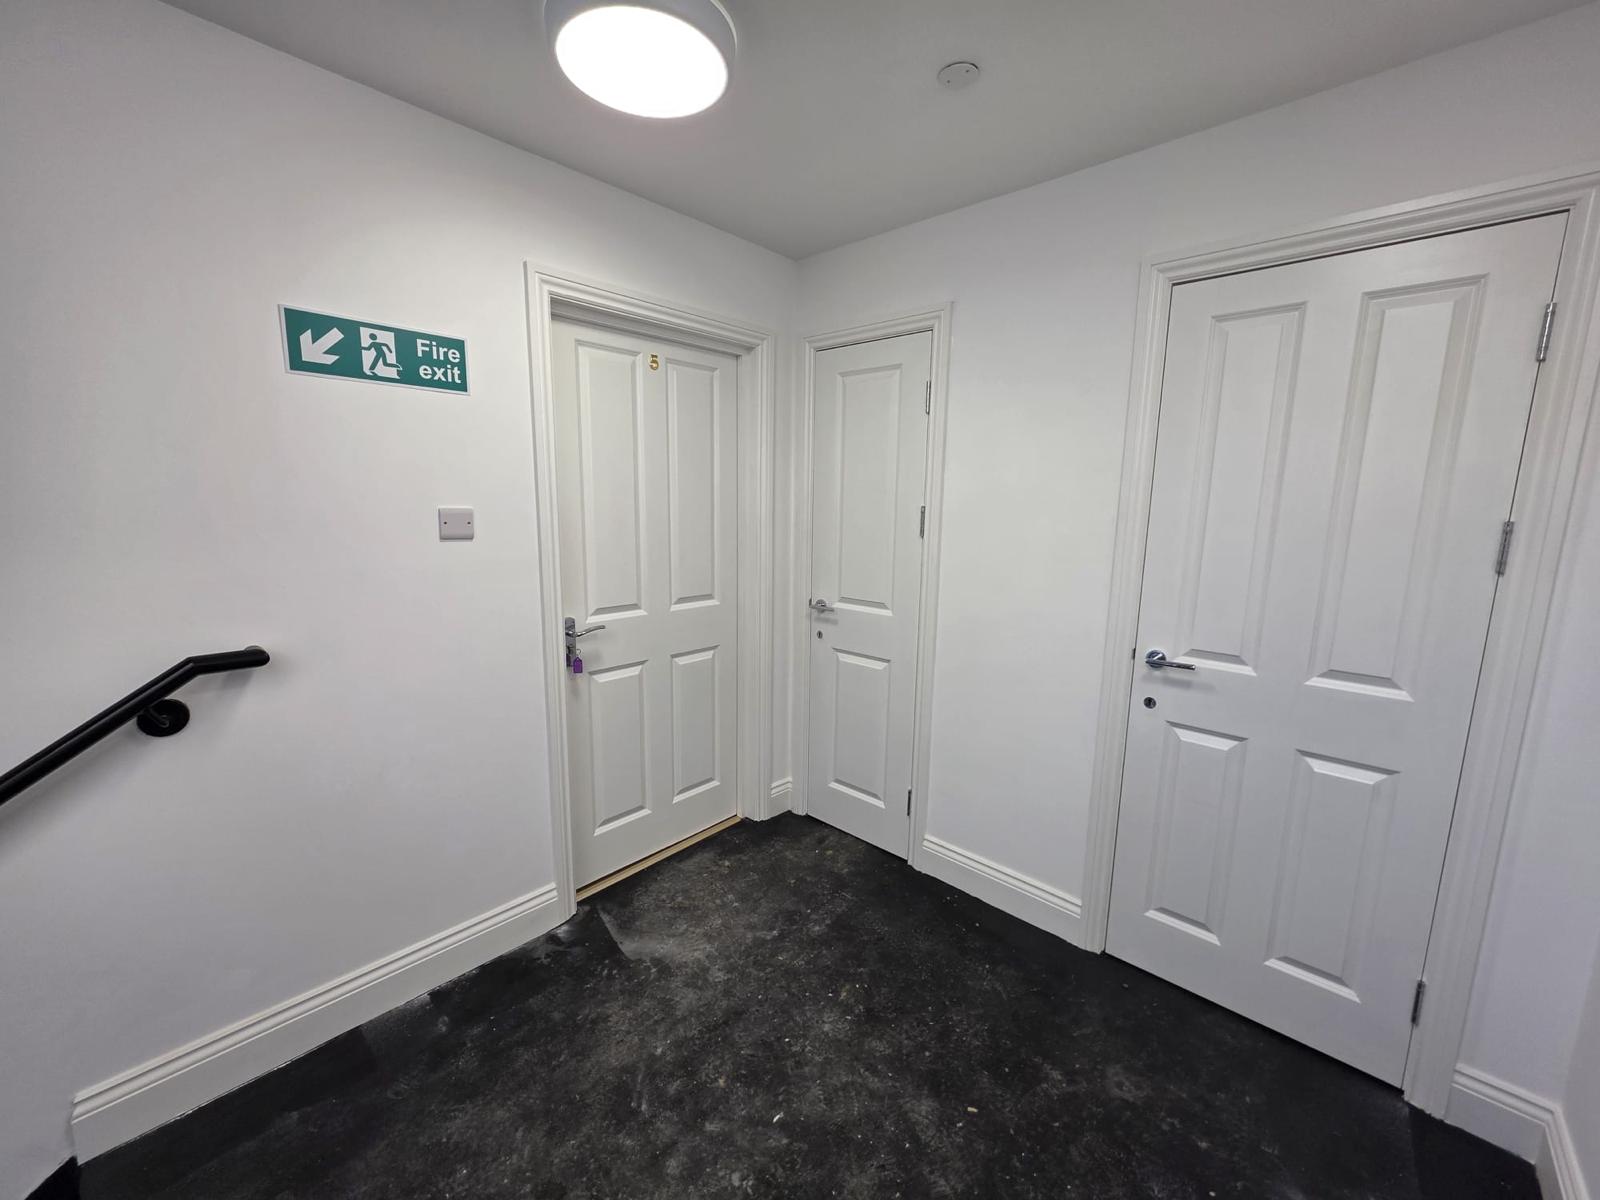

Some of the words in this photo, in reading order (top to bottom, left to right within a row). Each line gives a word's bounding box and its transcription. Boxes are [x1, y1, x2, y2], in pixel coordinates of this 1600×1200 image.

[416, 338, 461, 363] Fire
[649, 353, 660, 371] 5
[419, 364, 462, 384] exit
